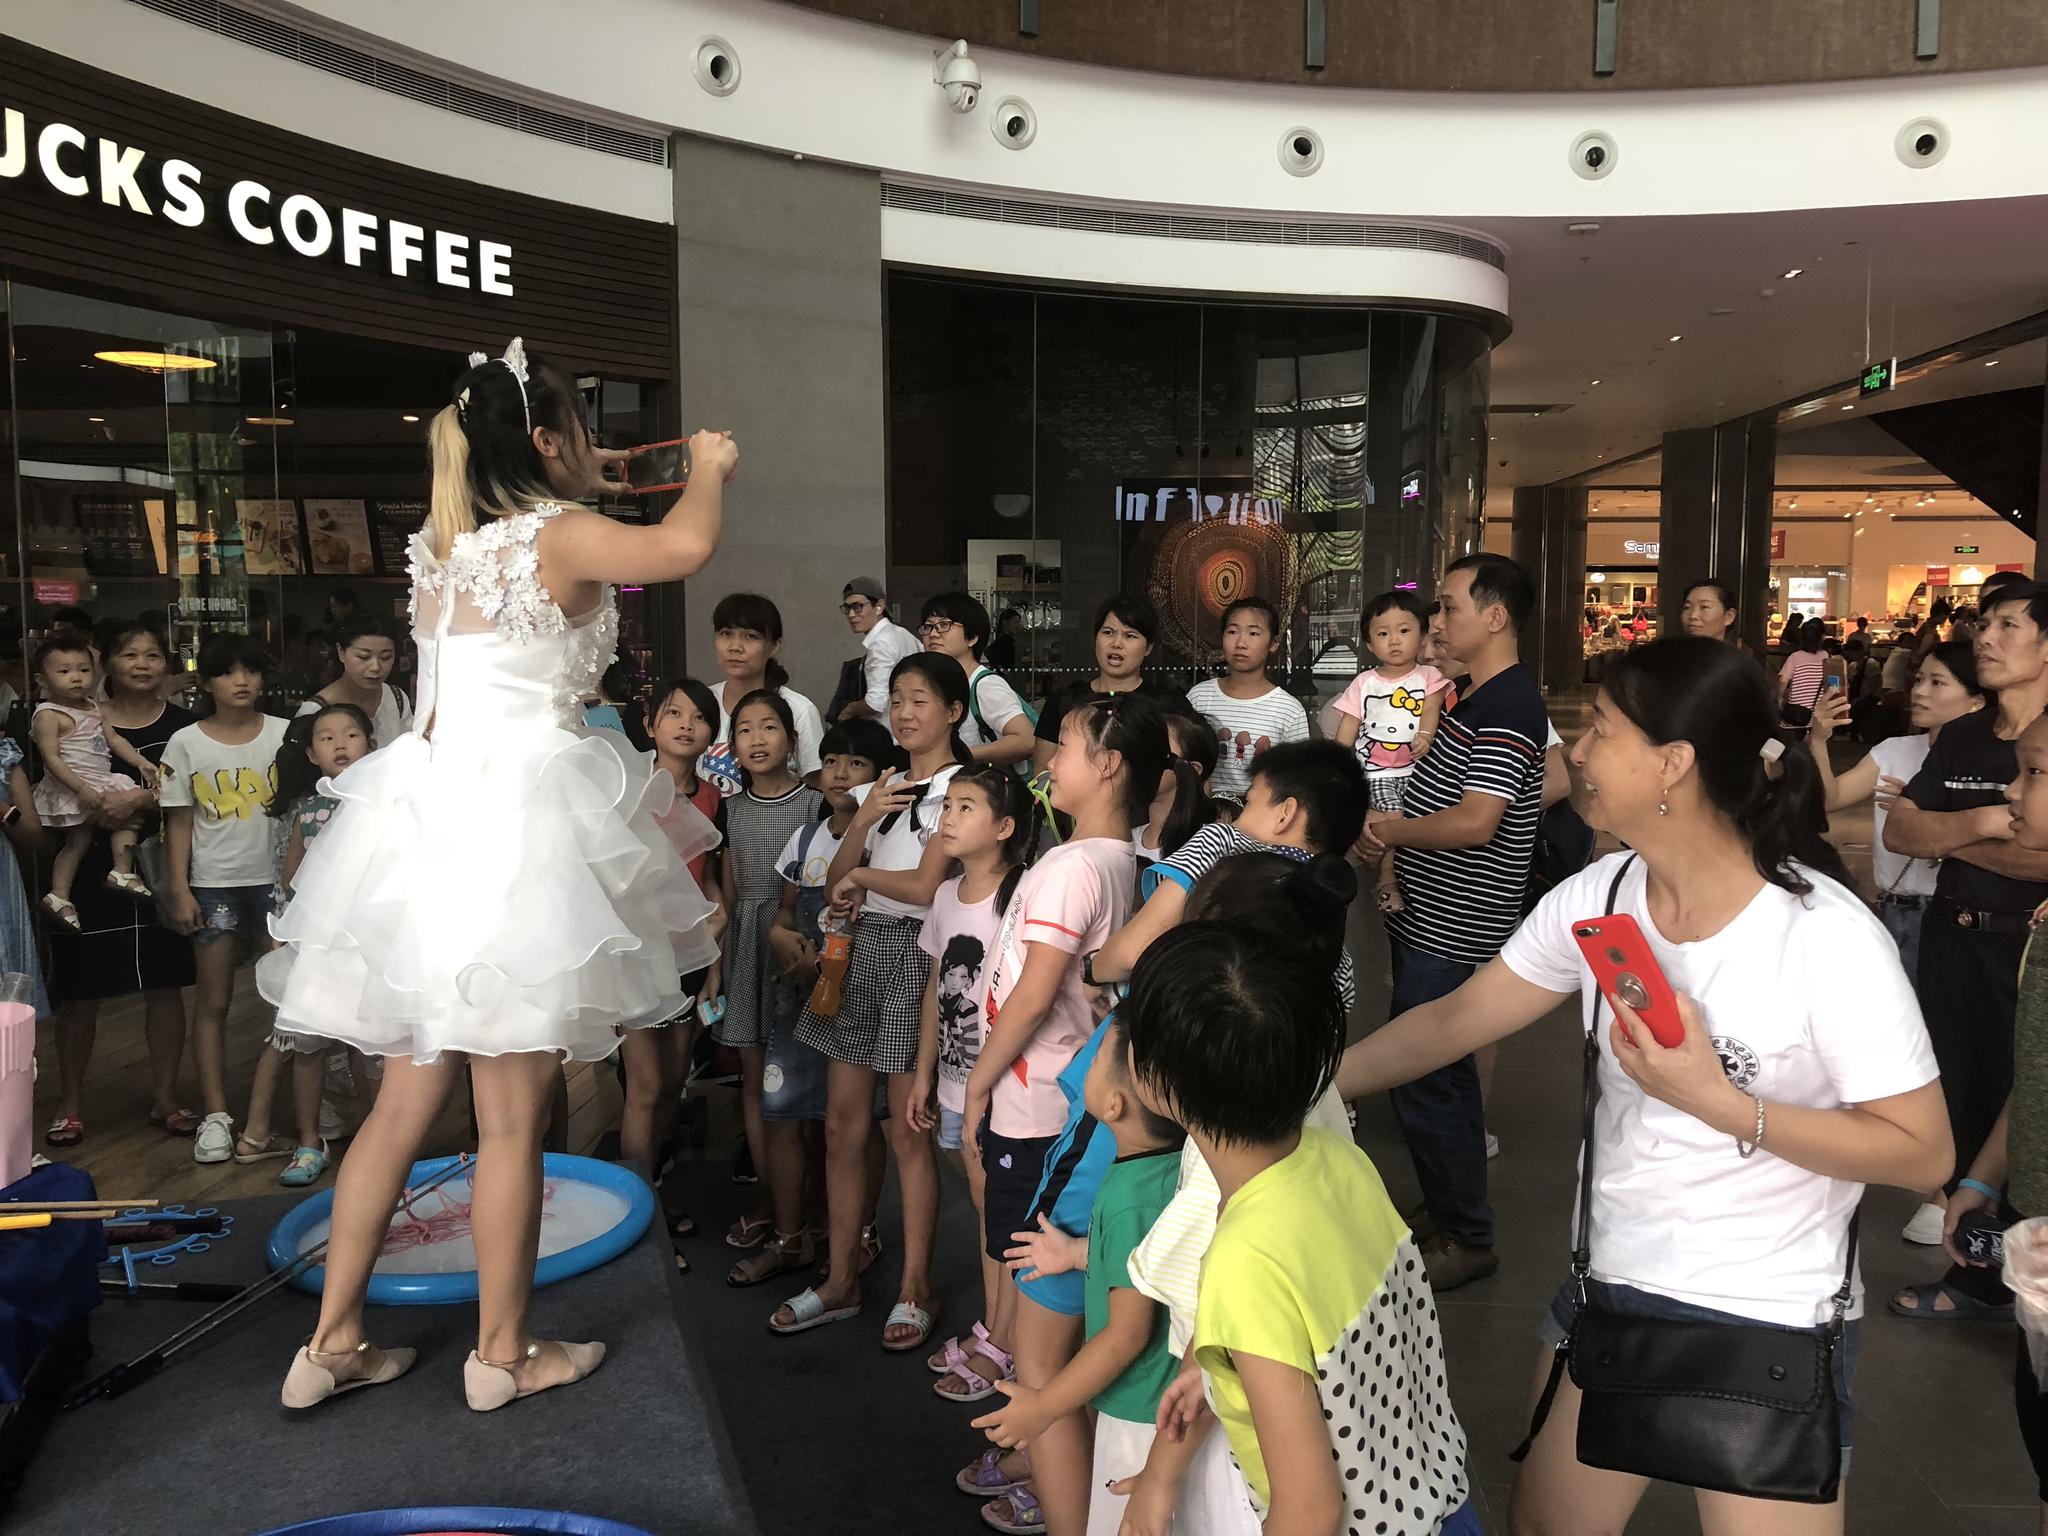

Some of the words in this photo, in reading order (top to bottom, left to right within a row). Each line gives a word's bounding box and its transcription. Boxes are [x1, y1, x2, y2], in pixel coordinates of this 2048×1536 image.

[227, 180, 514, 297] COFFEE
[178, 597, 206, 611] STORE
[208, 597, 237, 611] HOURS
